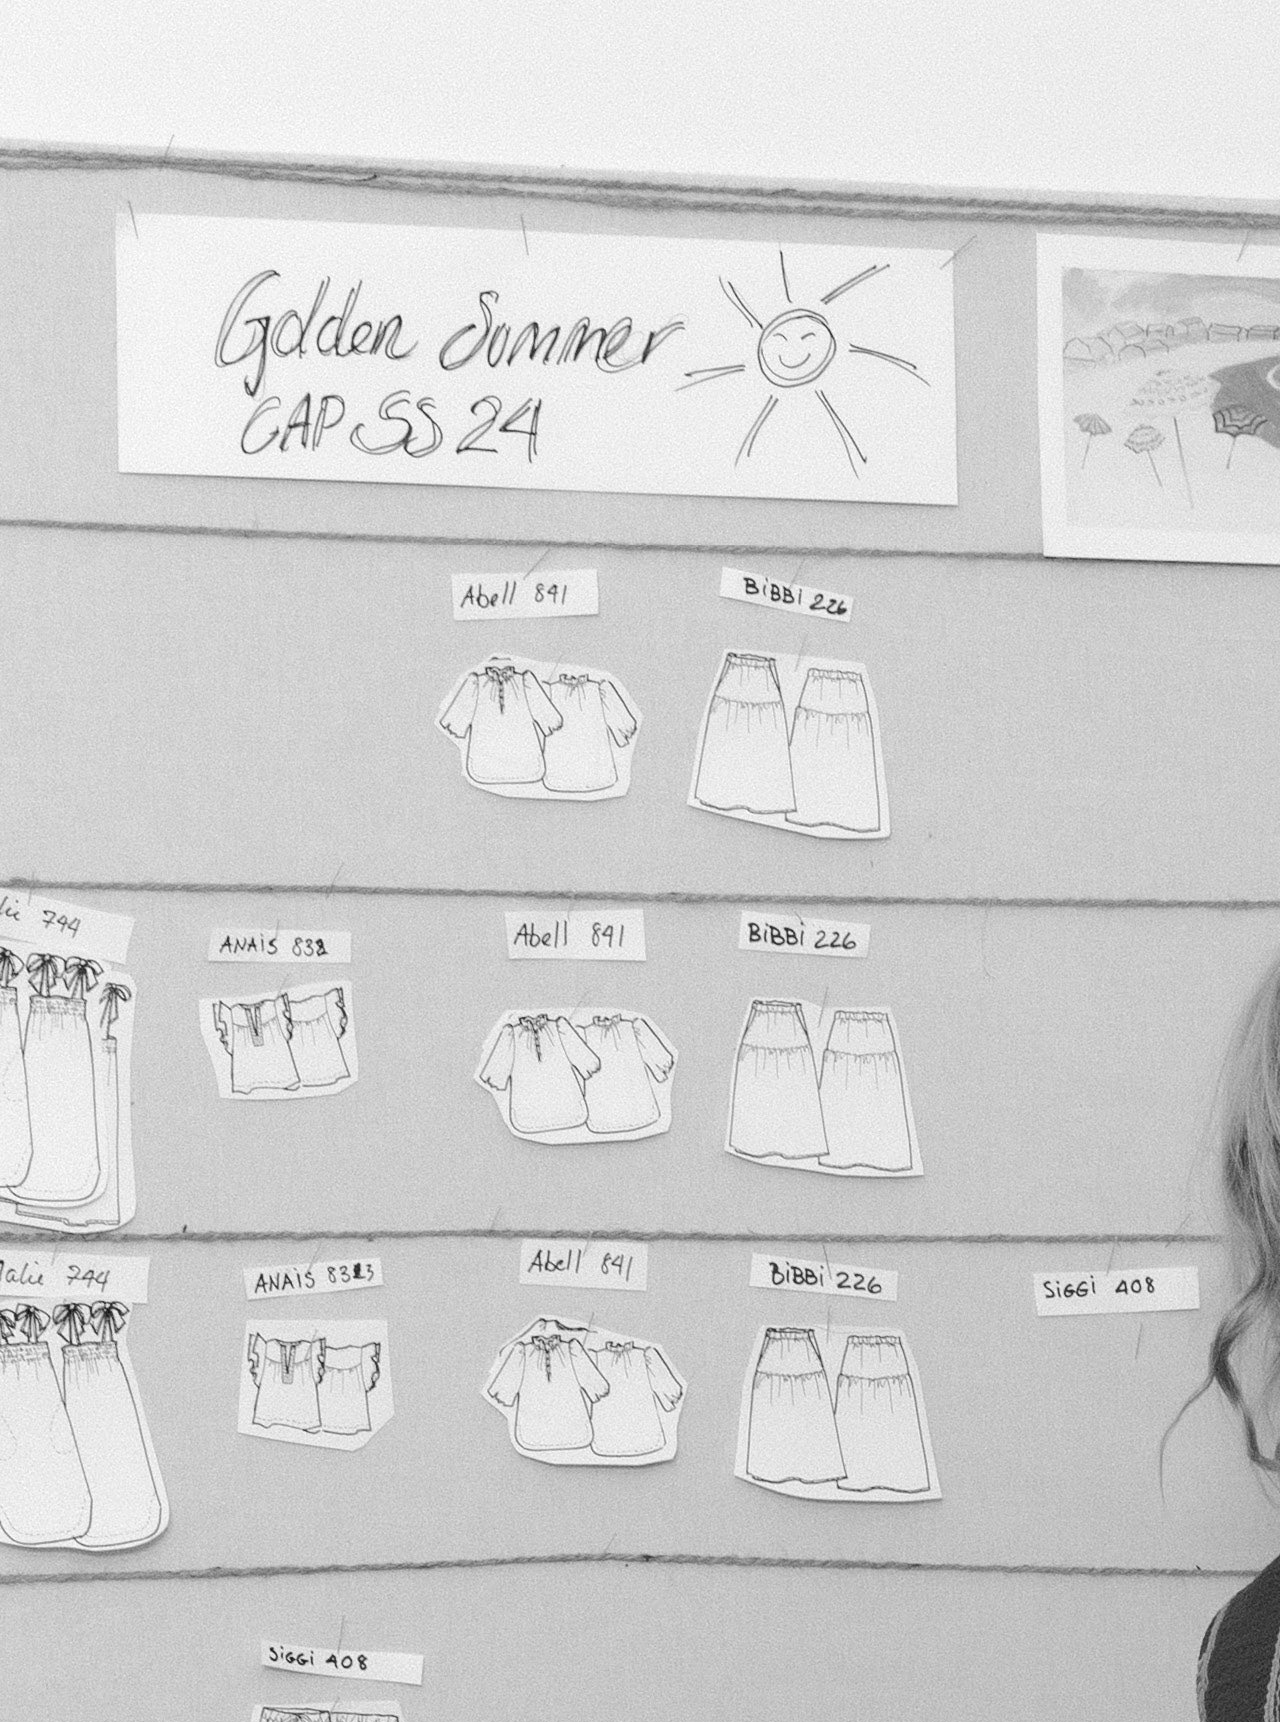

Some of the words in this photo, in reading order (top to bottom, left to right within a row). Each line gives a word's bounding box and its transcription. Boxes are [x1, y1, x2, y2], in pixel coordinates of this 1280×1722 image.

[241, 392, 346, 454] CAP
[460, 581, 517, 609] Abell
[534, 583, 568, 606] 841
[809, 593, 849, 616] 226
[41, 910, 82, 939] 744
[513, 920, 569, 949] Abell
[591, 921, 625, 949] 841
[814, 930, 858, 951] 226
[0, 1259, 44, 1286] alie
[67, 1264, 111, 1293] 744
[527, 1248, 582, 1274] Abell
[600, 1252, 634, 1282] 841
[836, 1271, 883, 1295] 226
[1115, 1276, 1156, 1295] 408
[325, 1654, 368, 1671] 408
